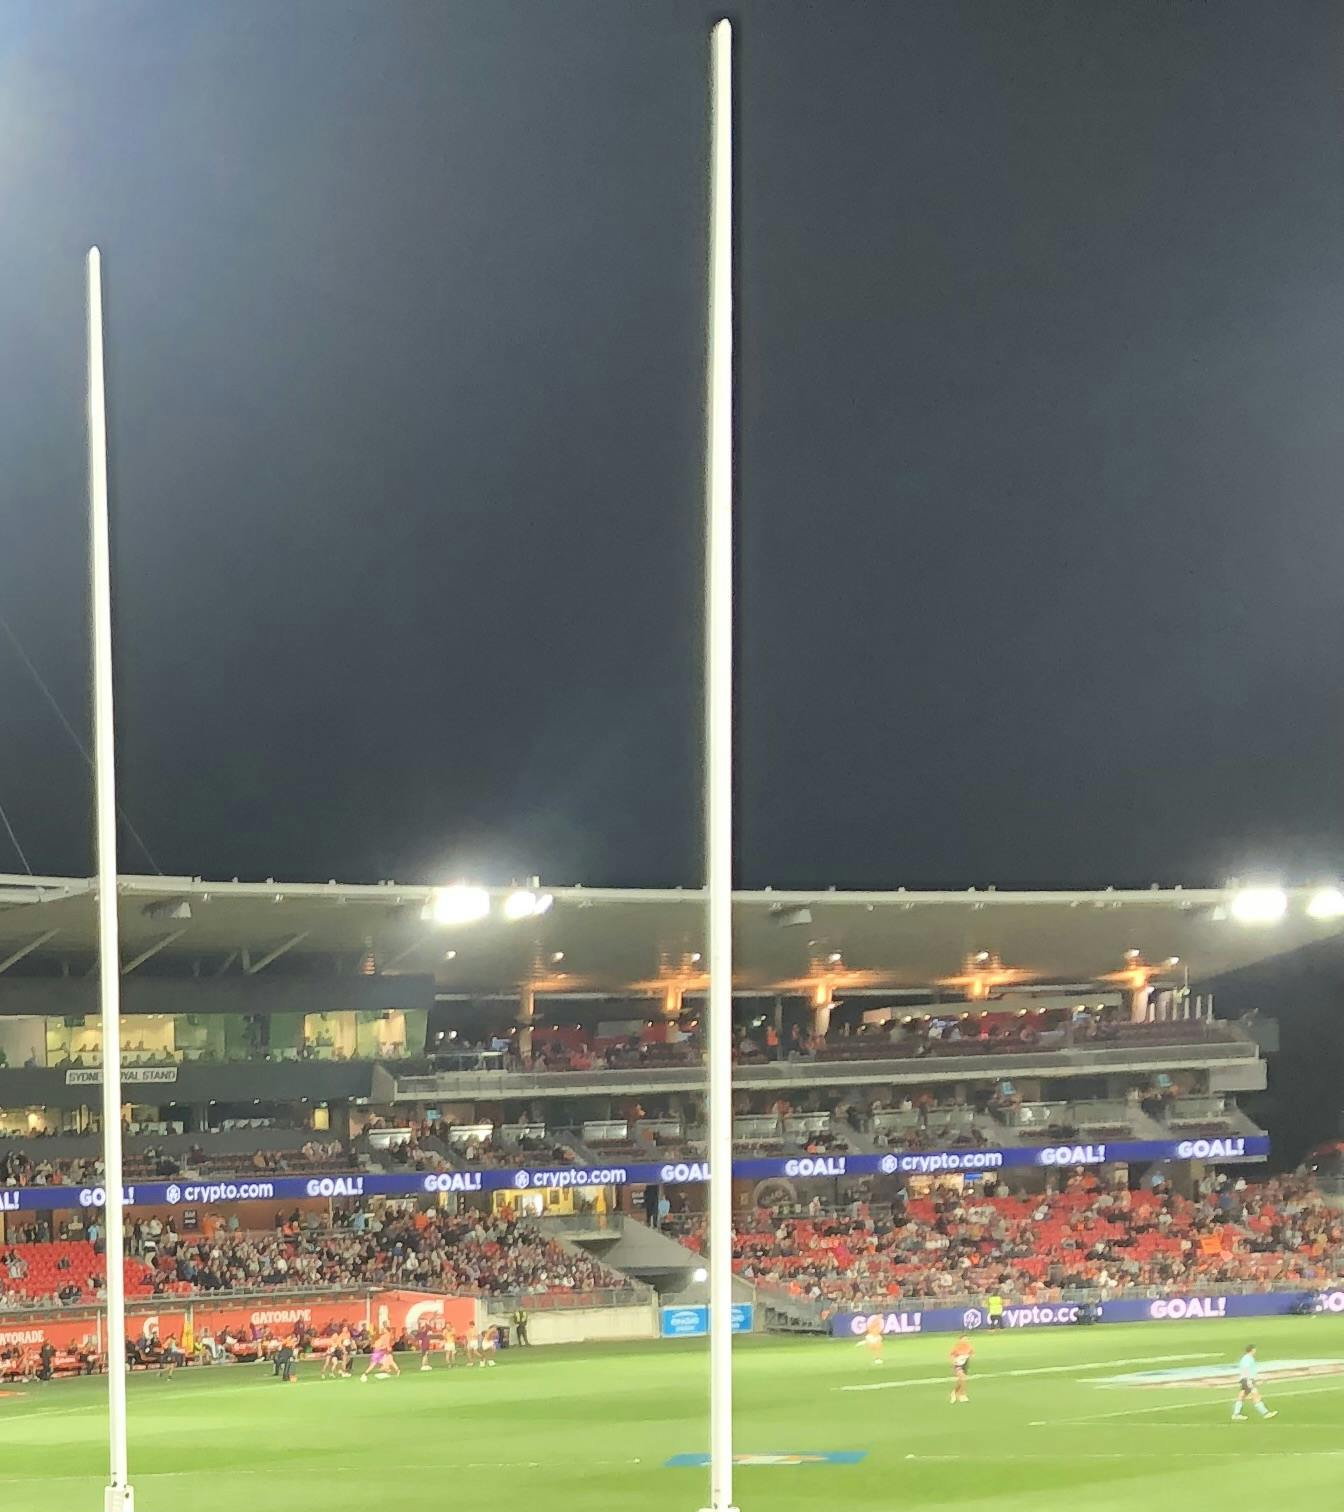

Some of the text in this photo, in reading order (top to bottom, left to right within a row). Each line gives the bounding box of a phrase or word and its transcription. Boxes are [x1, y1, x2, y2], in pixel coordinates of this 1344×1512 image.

[184, 1182, 274, 1204] crypto.com
[306, 1176, 363, 1196] GOAL!
[424, 1171, 481, 1192] GOAL!
[533, 1167, 627, 1188] crypto.com
[785, 1157, 846, 1177] GOAL!
[902, 1150, 1002, 1173] crypto.com
[1041, 1145, 1106, 1166] GOAL!
[1177, 1138, 1245, 1159] GOAL!
[251, 1309, 311, 1325] GATORADE
[1150, 1300, 1226, 1321] GOAL!
